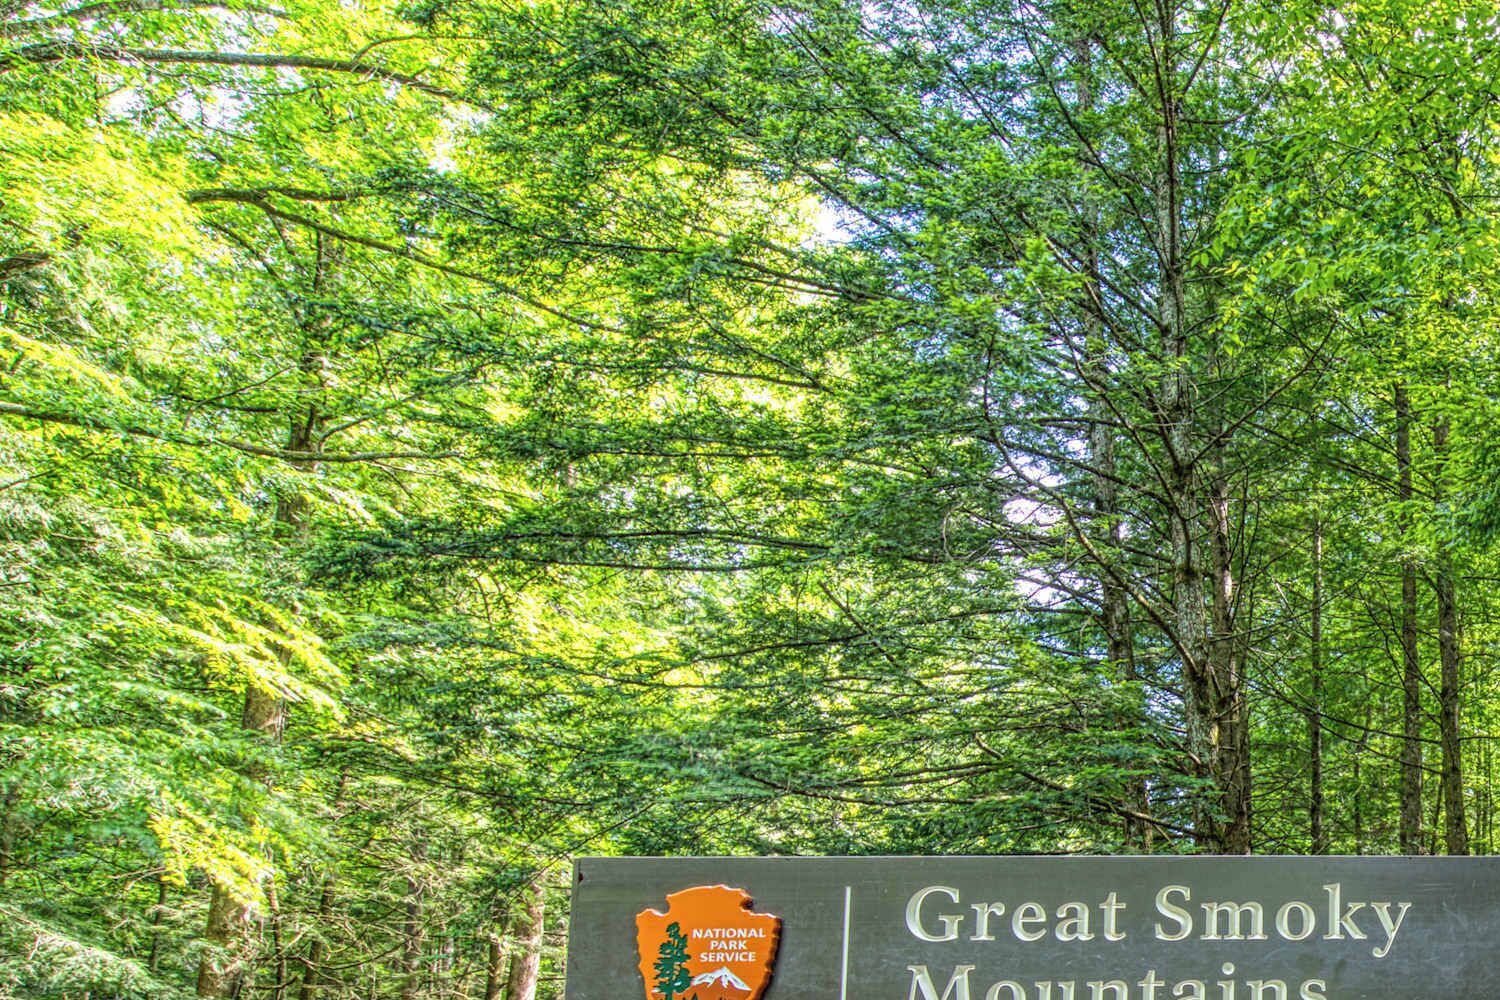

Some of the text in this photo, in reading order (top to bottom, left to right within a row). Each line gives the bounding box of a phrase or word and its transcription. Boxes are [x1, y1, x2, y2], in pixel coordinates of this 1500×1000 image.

[905, 882, 1413, 959] Great Smoky
[692, 927, 767, 938] NATIONAL
[710, 940, 748, 950] PARK
[699, 951, 757, 963] SERVICE
